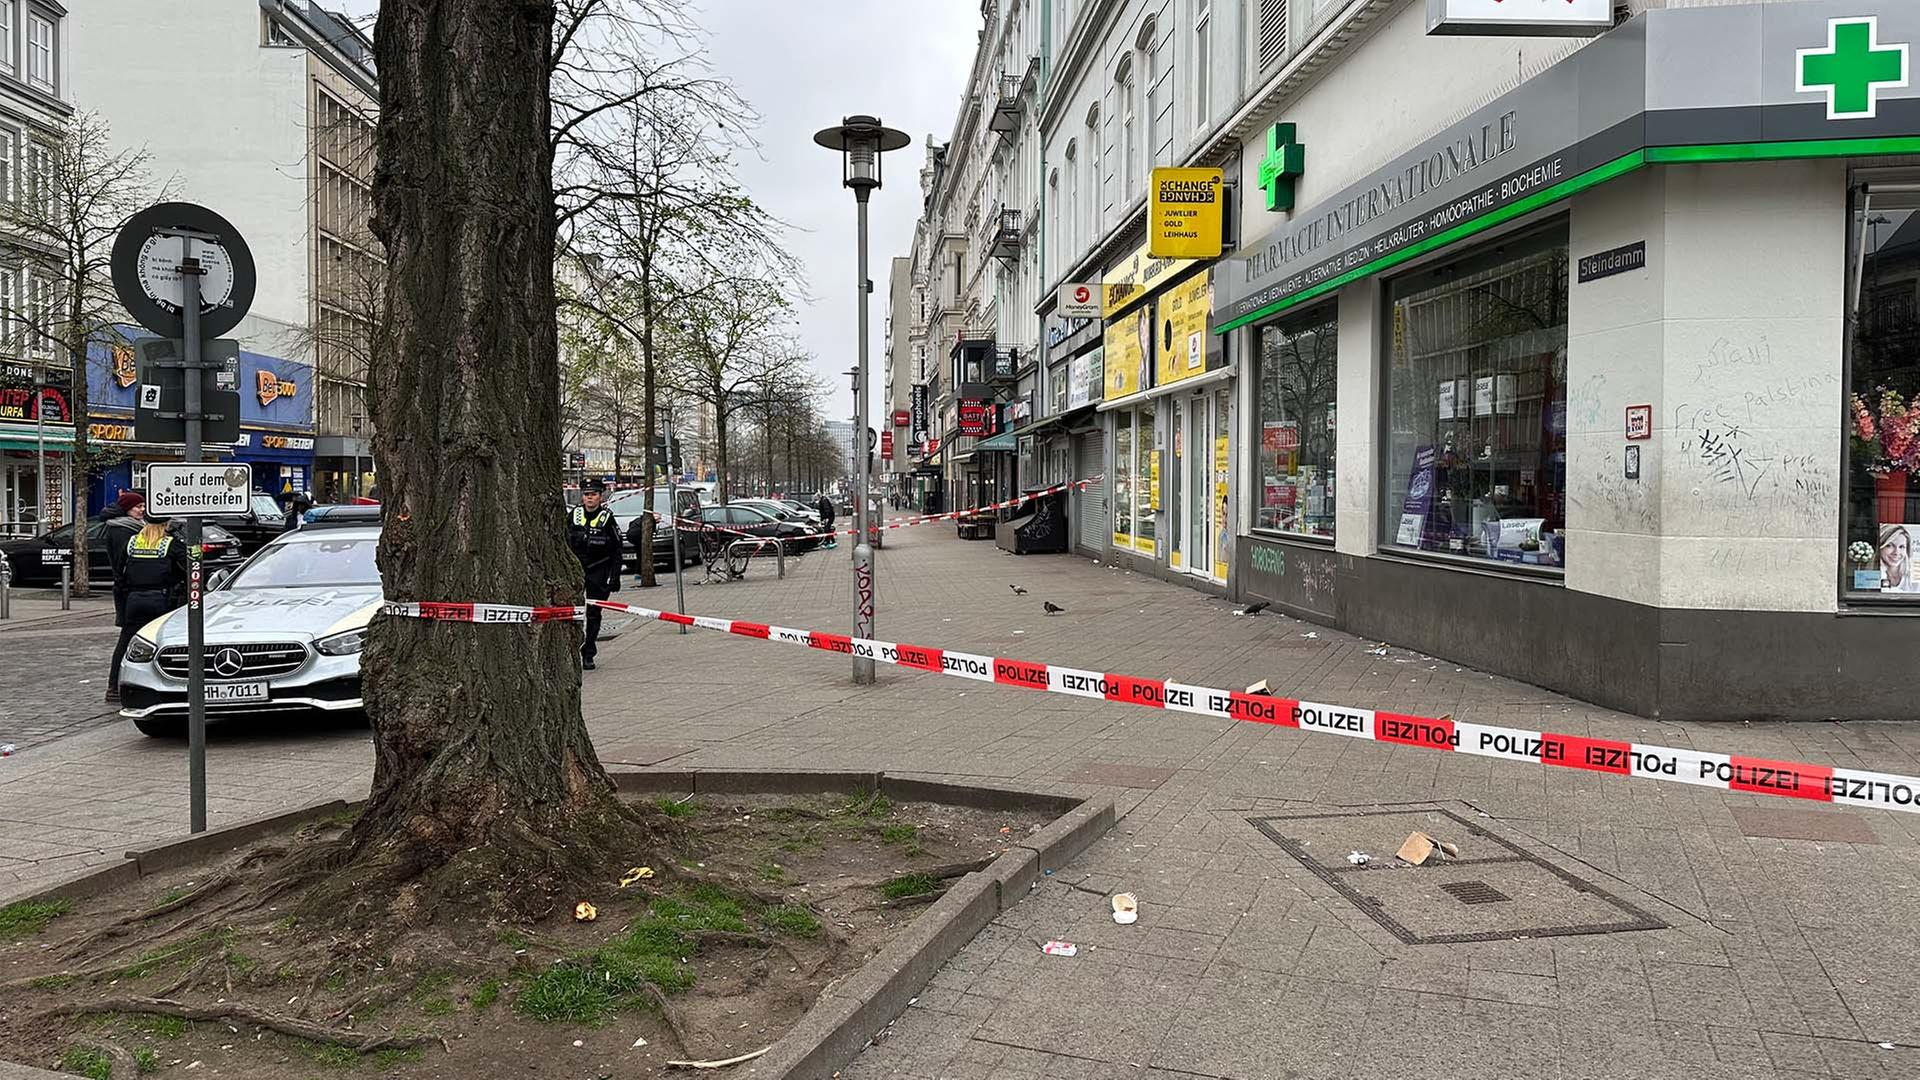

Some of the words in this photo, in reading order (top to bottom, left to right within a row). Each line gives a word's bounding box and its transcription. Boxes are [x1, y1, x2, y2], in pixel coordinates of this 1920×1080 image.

[1245, 218, 1325, 283] PHARMACIE
[1326, 108, 1518, 241] INTERNATIONALE
[1374, 220, 1424, 255] HEILKRÄUTER
[1430, 188, 1494, 230] HOMÖOPATHIE
[1501, 158, 1562, 200] BIOCHEMIE
[1581, 249, 1644, 277] Steindamm
[174, 472, 194, 486] auf
[200, 472, 225, 486] dem
[155, 491, 242, 506] Seitenstreifen
[420, 606, 471, 619] POLIZEI
[228, 684, 261, 698] 7011
[882, 647, 929, 666] POLIZEI
[939, 655, 987, 675] POLIZEI
[997, 664, 1050, 685] POLIZEI
[1062, 674, 1119, 696] POLIZEI
[1132, 684, 1193, 708] POLIZEI
[1209, 694, 1275, 720] POLIZEI
[1291, 706, 1363, 732] POLIZEI
[1382, 719, 1460, 747] POLIZEI
[1480, 732, 1564, 761] POLIZEI
[1585, 745, 1676, 775] POLIZEI
[1700, 760, 1799, 791] POLIZEI
